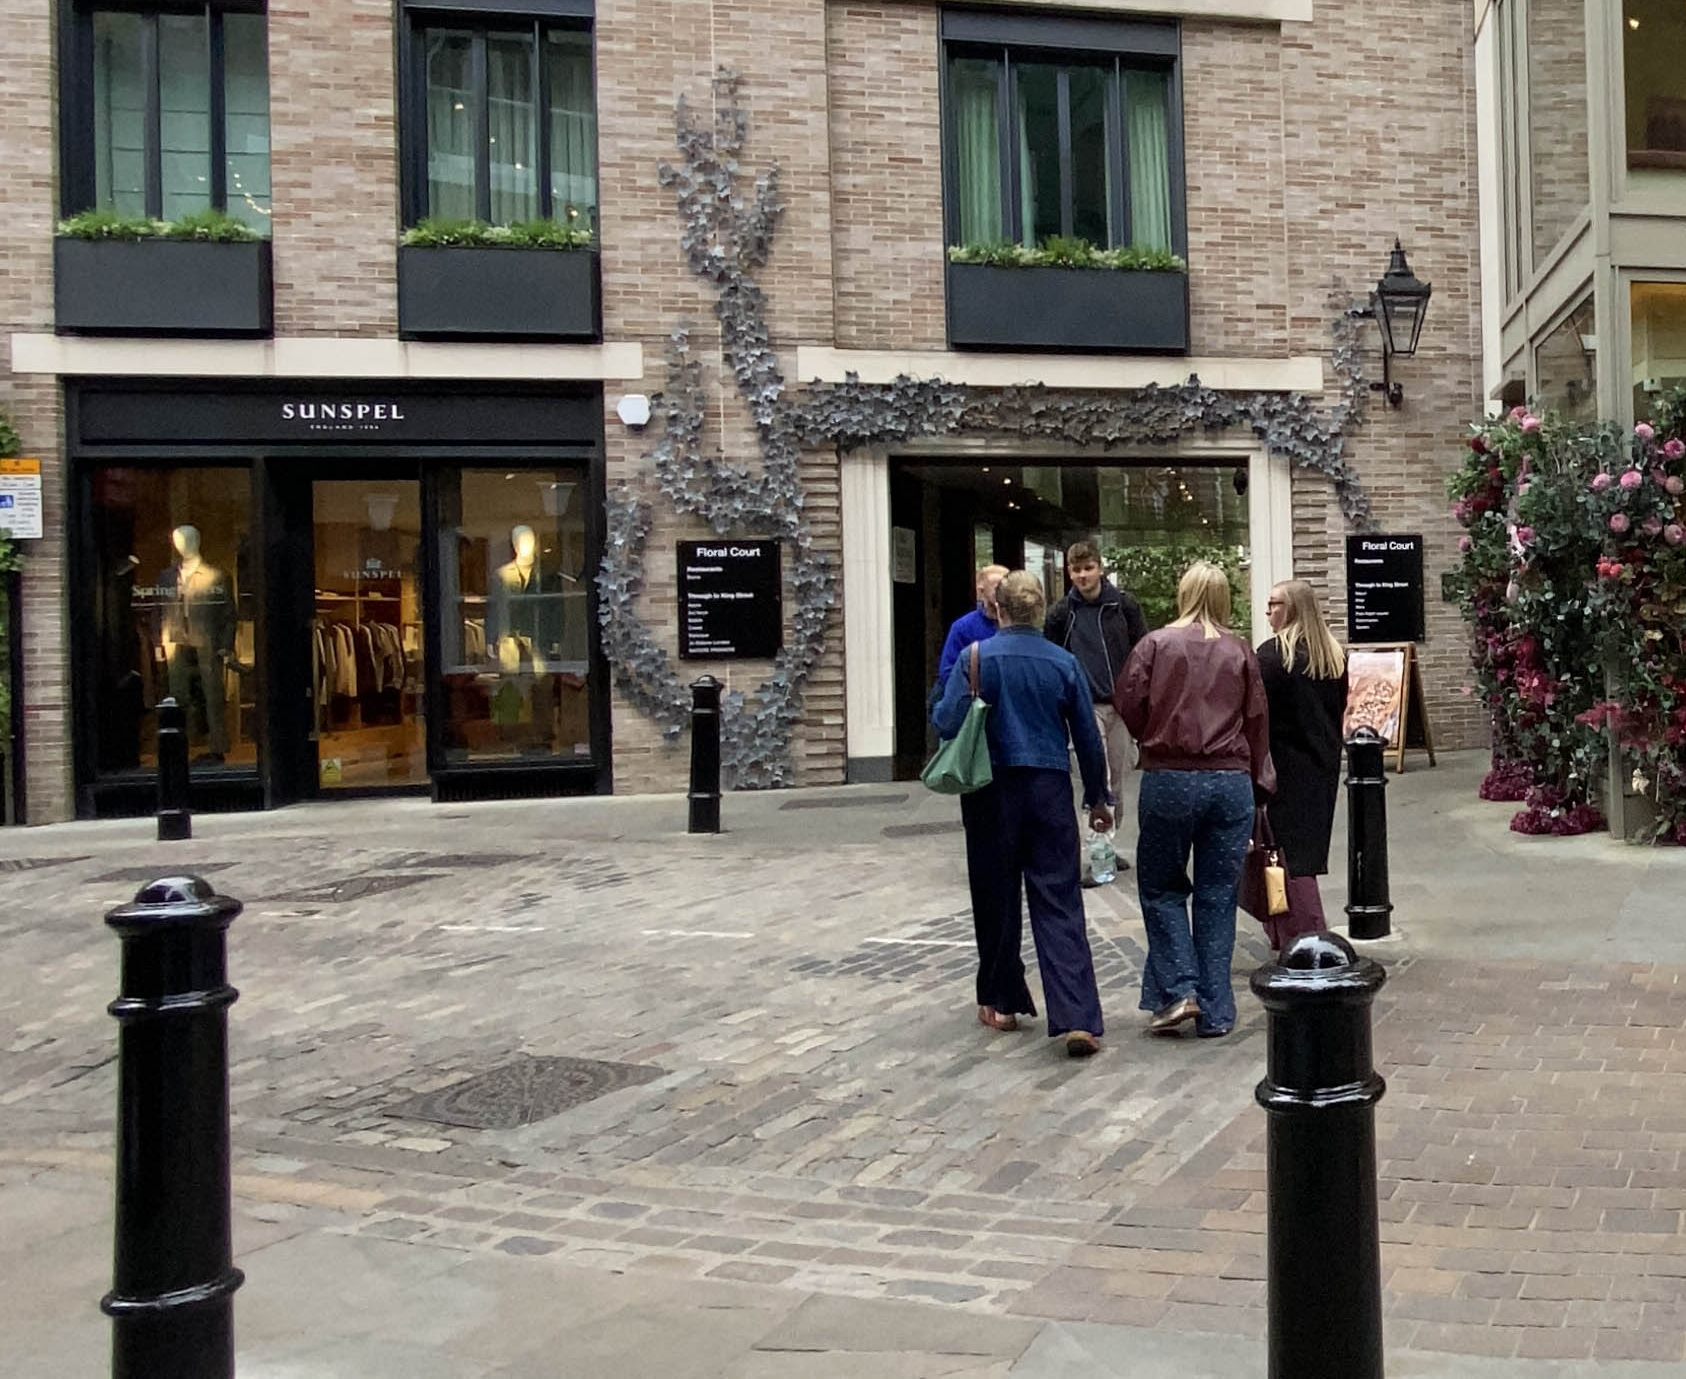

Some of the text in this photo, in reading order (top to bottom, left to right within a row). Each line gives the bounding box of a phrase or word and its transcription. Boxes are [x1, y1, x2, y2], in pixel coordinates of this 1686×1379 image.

[282, 403, 404, 419] SUNSPEL
[1362, 541, 1414, 550] Floral Court
[696, 547, 761, 557] Floral Court
